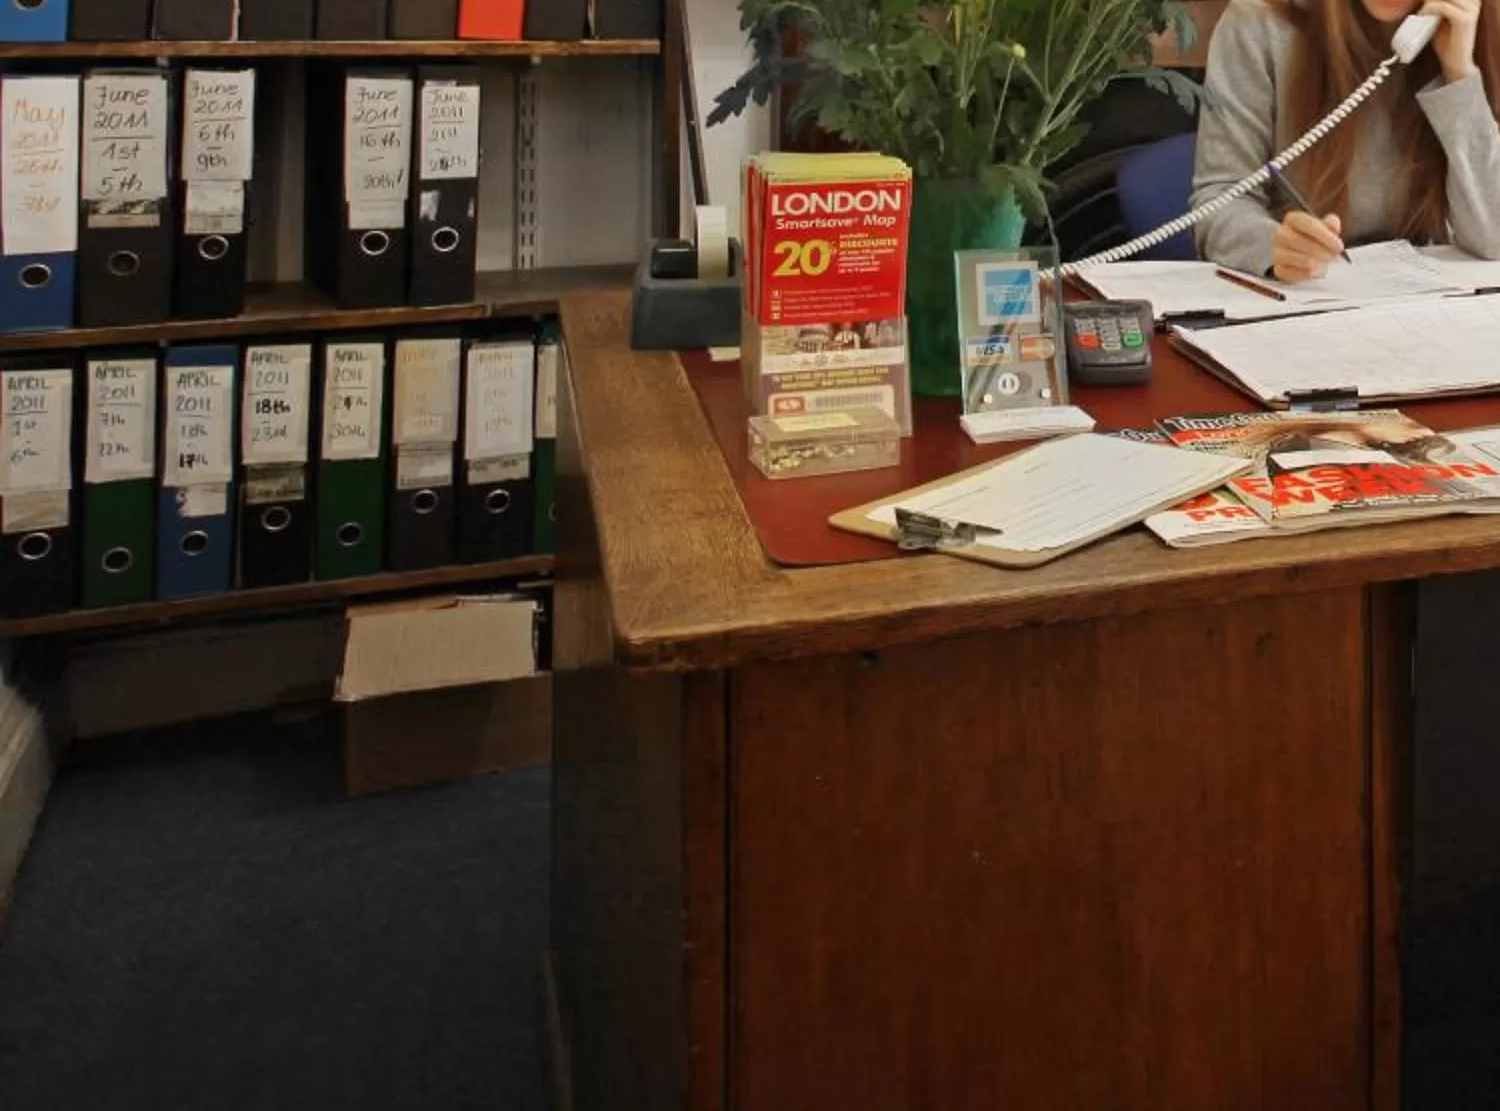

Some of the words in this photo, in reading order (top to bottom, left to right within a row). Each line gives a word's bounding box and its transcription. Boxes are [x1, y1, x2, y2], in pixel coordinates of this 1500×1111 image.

[95, 85, 150, 107] June
[190, 81, 239, 96] June
[354, 87, 399, 104] June
[193, 99, 243, 114] 2011
[352, 106, 401, 124] 2011
[93, 111, 149, 130] 2011
[101, 142, 141, 160] 1st
[196, 154, 228, 172] 9th
[100, 174, 143, 194] 5th
[771, 189, 901, 217] LONDON
[863, 214, 896, 228] Map
[7, 376, 52, 390] APRIL
[11, 396, 46, 411] 2011
[1231, 462, 1500, 493] FASHION
[1185, 505, 1261, 522] PR
